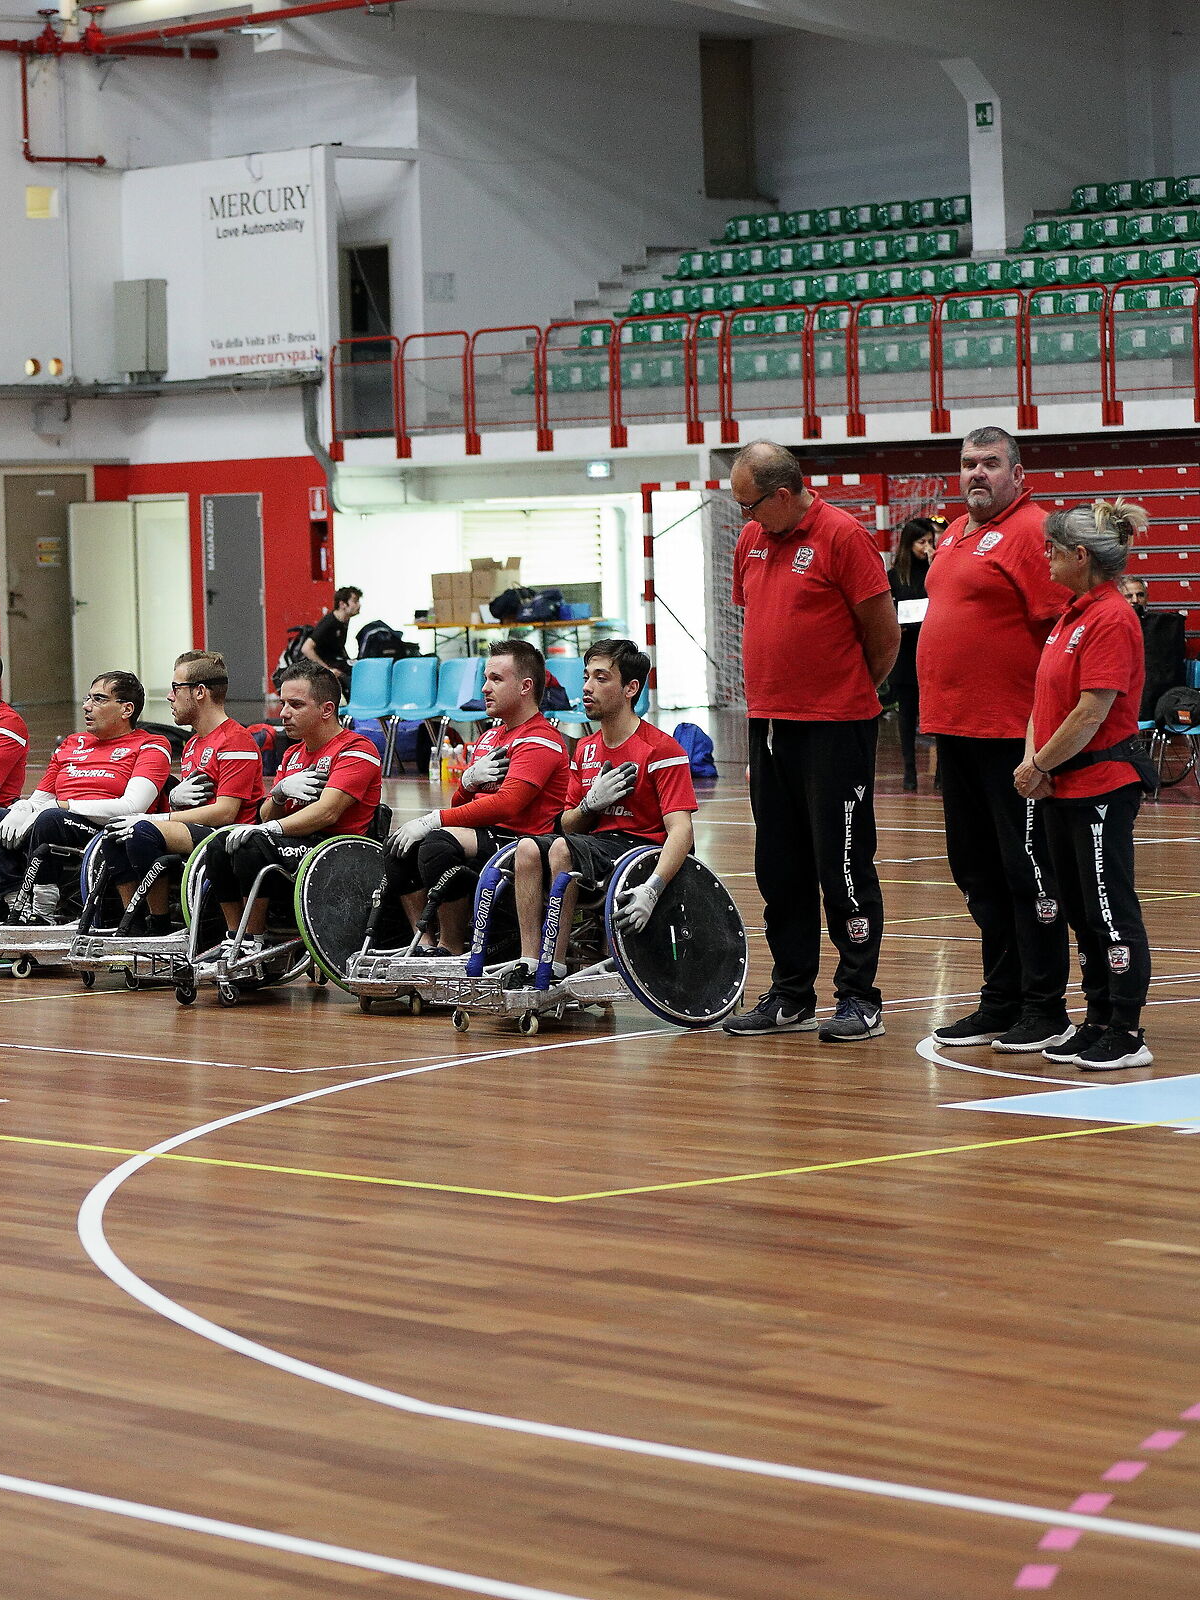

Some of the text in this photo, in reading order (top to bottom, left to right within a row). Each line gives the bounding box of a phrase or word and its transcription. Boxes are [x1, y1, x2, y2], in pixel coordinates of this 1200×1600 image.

[209, 184, 310, 220] MERCURY
[216, 218, 304, 239] Love Automobility
[288, 332, 316, 343] Brescia
[77, 736, 87, 750] 5
[480, 730, 498, 744] 12
[583, 744, 597, 762] 13
[1090, 822, 1121, 942] WHEELCHAIR
